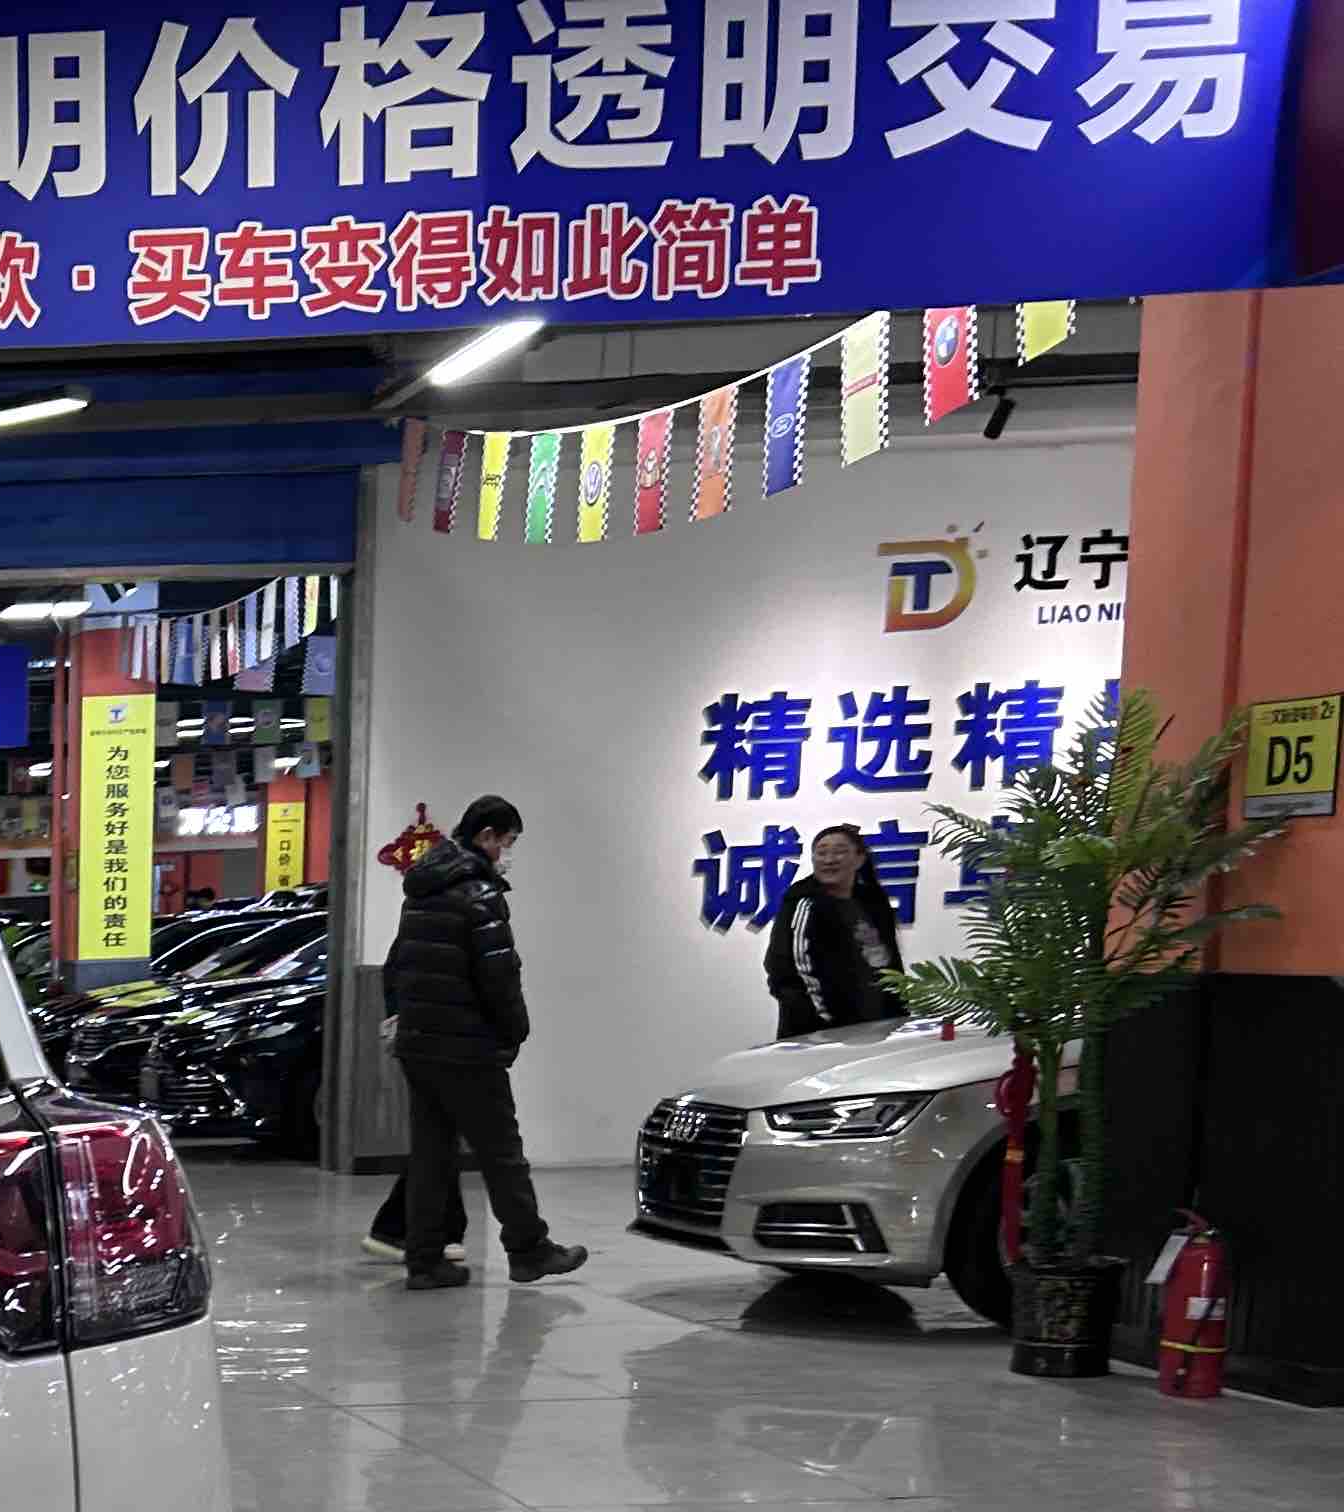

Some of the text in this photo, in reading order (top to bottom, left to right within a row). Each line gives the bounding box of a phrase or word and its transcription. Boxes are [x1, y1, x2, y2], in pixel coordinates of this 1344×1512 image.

[1014, 529, 1129, 592] 辽宁
[1038, 602, 1126, 625] LIAO NI
[701, 679, 1120, 800] 精选精
[1265, 735, 1315, 786] D5
[102, 745, 129, 948] 为您服务好是我们的责任
